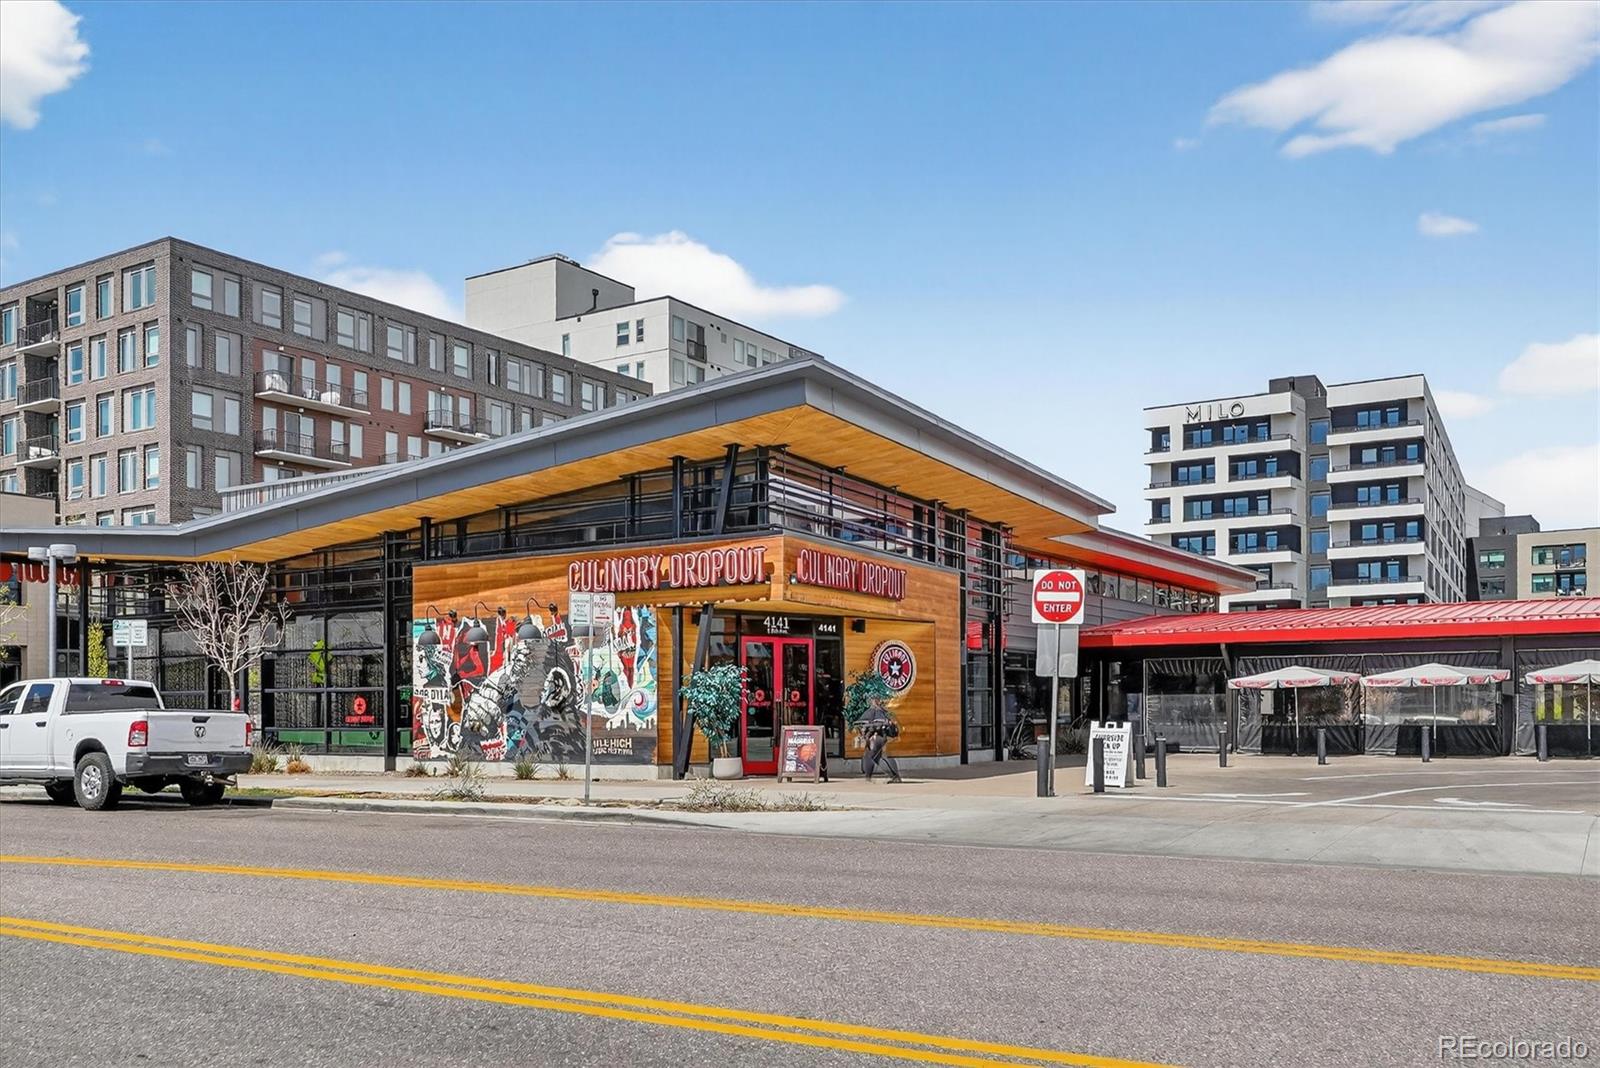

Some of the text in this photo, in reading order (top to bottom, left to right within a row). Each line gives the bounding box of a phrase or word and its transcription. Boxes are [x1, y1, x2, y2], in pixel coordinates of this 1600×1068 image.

[1185, 401, 1245, 423] MILO
[568, 546, 769, 593] CULINARY DROPOUT
[799, 549, 907, 601] CULINARY DROPOUT
[1041, 581, 1077, 590] DO NOT
[1043, 603, 1072, 613] ENTER
[763, 616, 790, 629] 4141
[818, 624, 836, 632] 4141
[610, 738, 632, 749] HIGH
